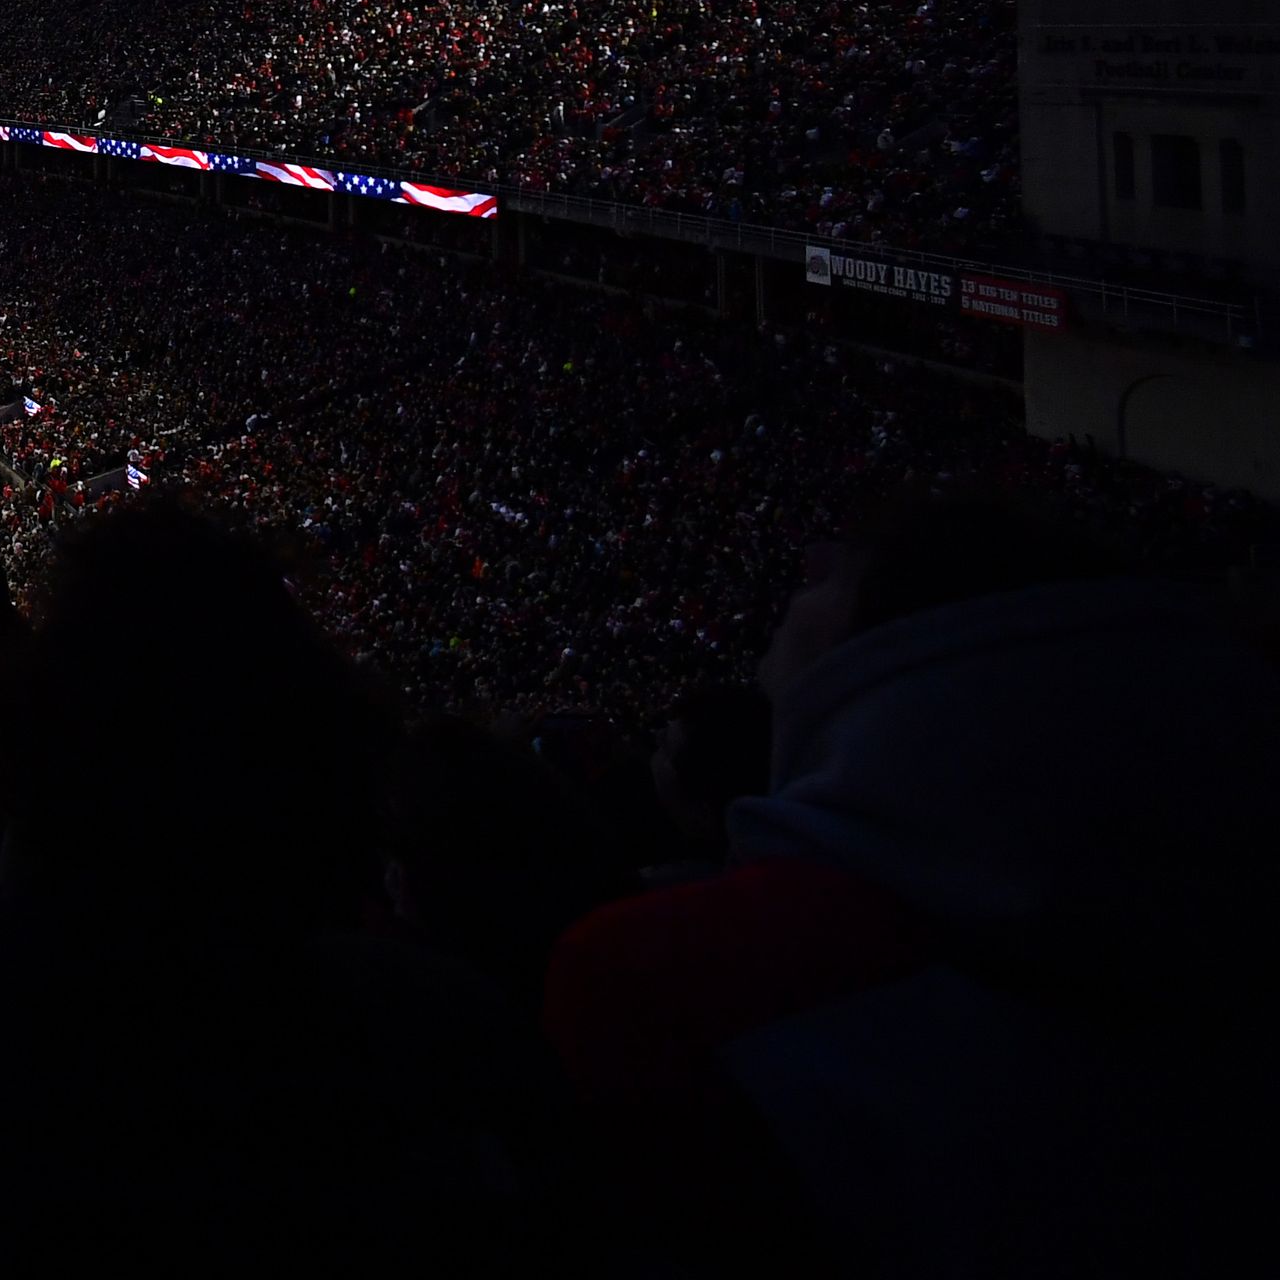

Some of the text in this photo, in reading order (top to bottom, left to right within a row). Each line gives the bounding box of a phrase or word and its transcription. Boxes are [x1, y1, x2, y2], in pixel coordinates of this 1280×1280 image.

[829, 254, 952, 297] WOODY HAYES
[960, 278, 976, 294] 13
[1020, 291, 1059, 310] TITLES
[961, 295, 1059, 327] 5 NATIONAL TITLES
